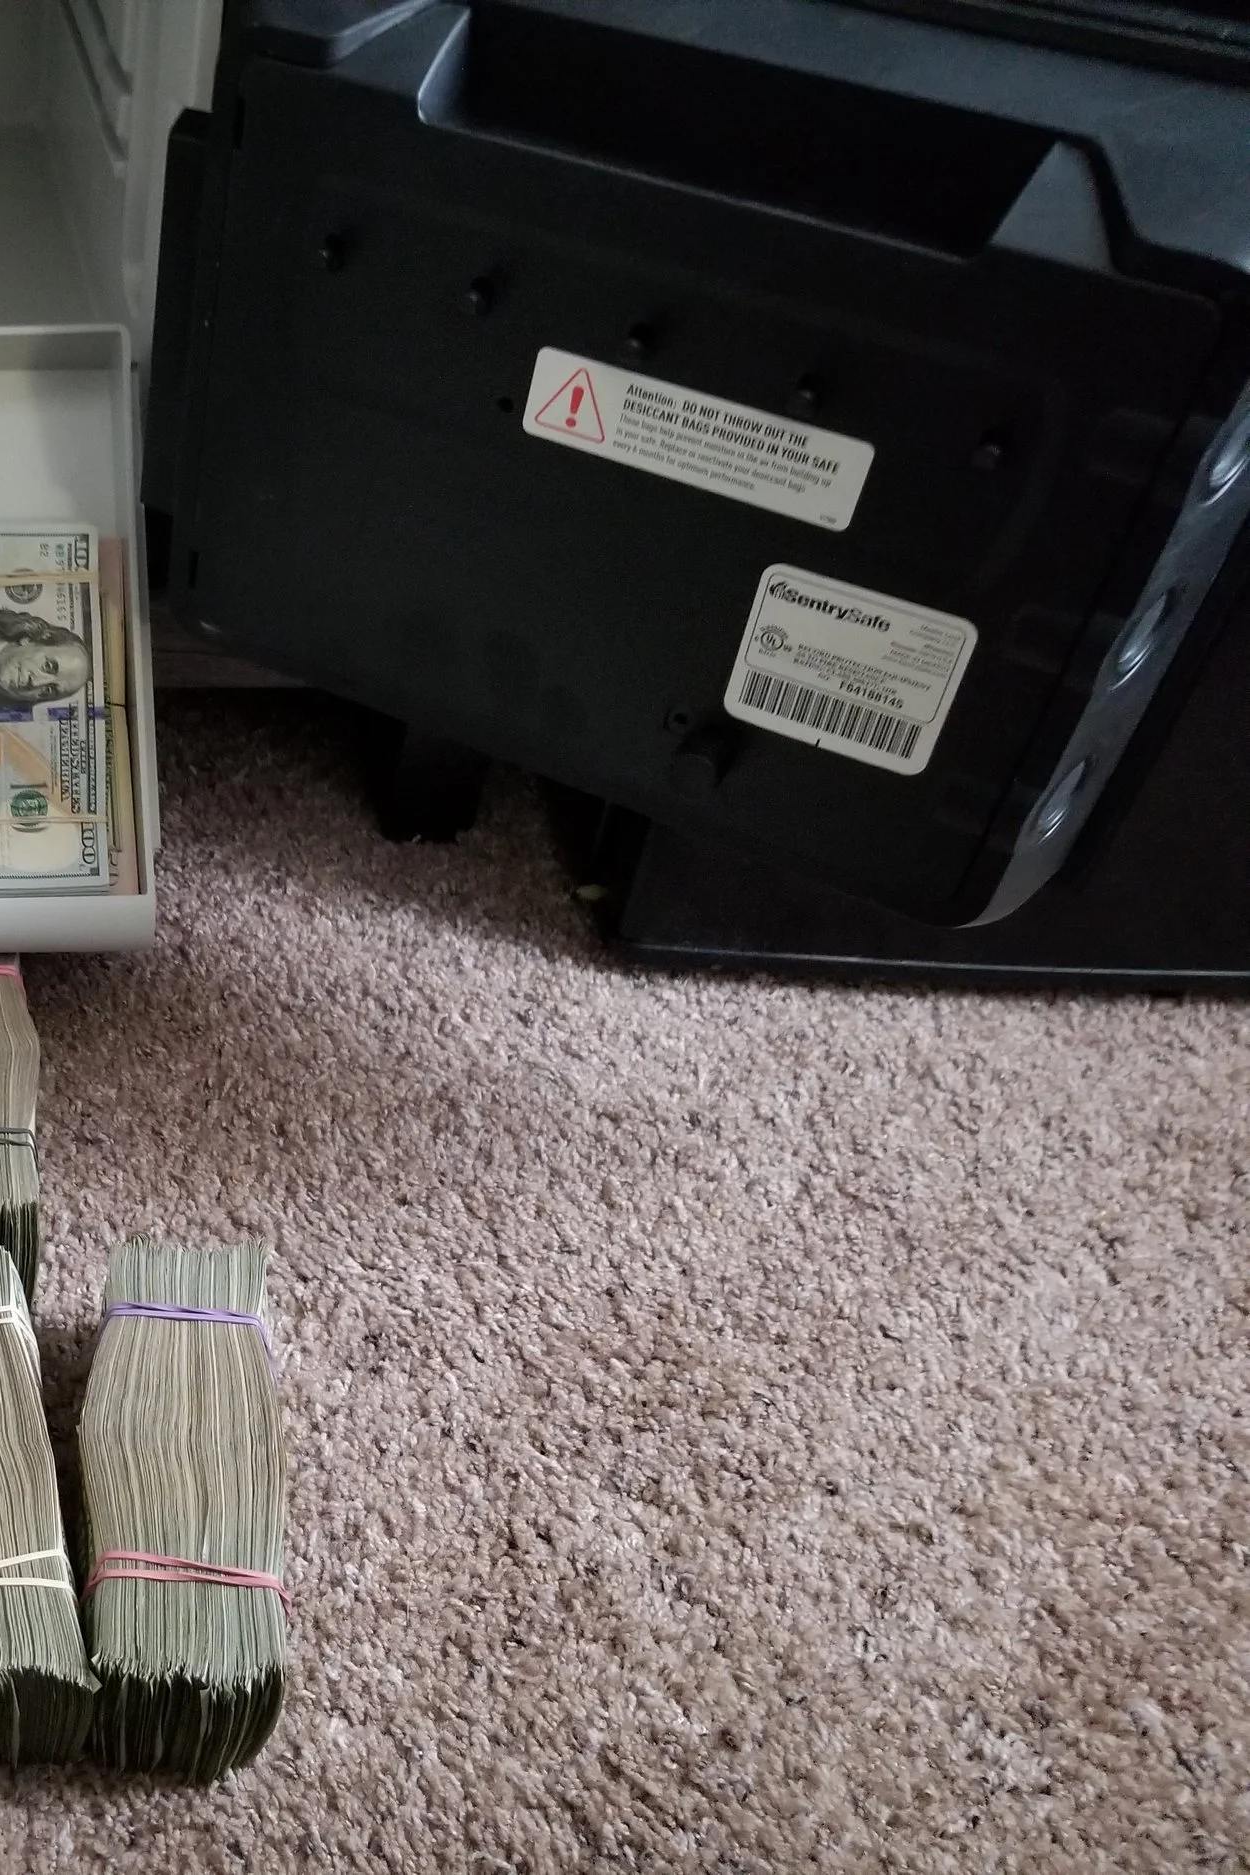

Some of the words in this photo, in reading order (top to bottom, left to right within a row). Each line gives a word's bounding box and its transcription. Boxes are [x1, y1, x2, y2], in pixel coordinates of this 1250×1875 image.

[622, 399, 678, 424] DESICCANT
[681, 417, 710, 434] BAGS
[711, 426, 765, 450] PROVIDED
[766, 443, 779, 455] IN
[780, 447, 809, 465] YOUR
[811, 456, 839, 474] SAFE
[682, 401, 697, 413] DO
[698, 406, 719, 420] NOT
[723, 413, 762, 433] THROW
[764, 425, 784, 440] OUT
[788, 432, 808, 447] THE
[784, 589, 892, 633] SentrySafe
